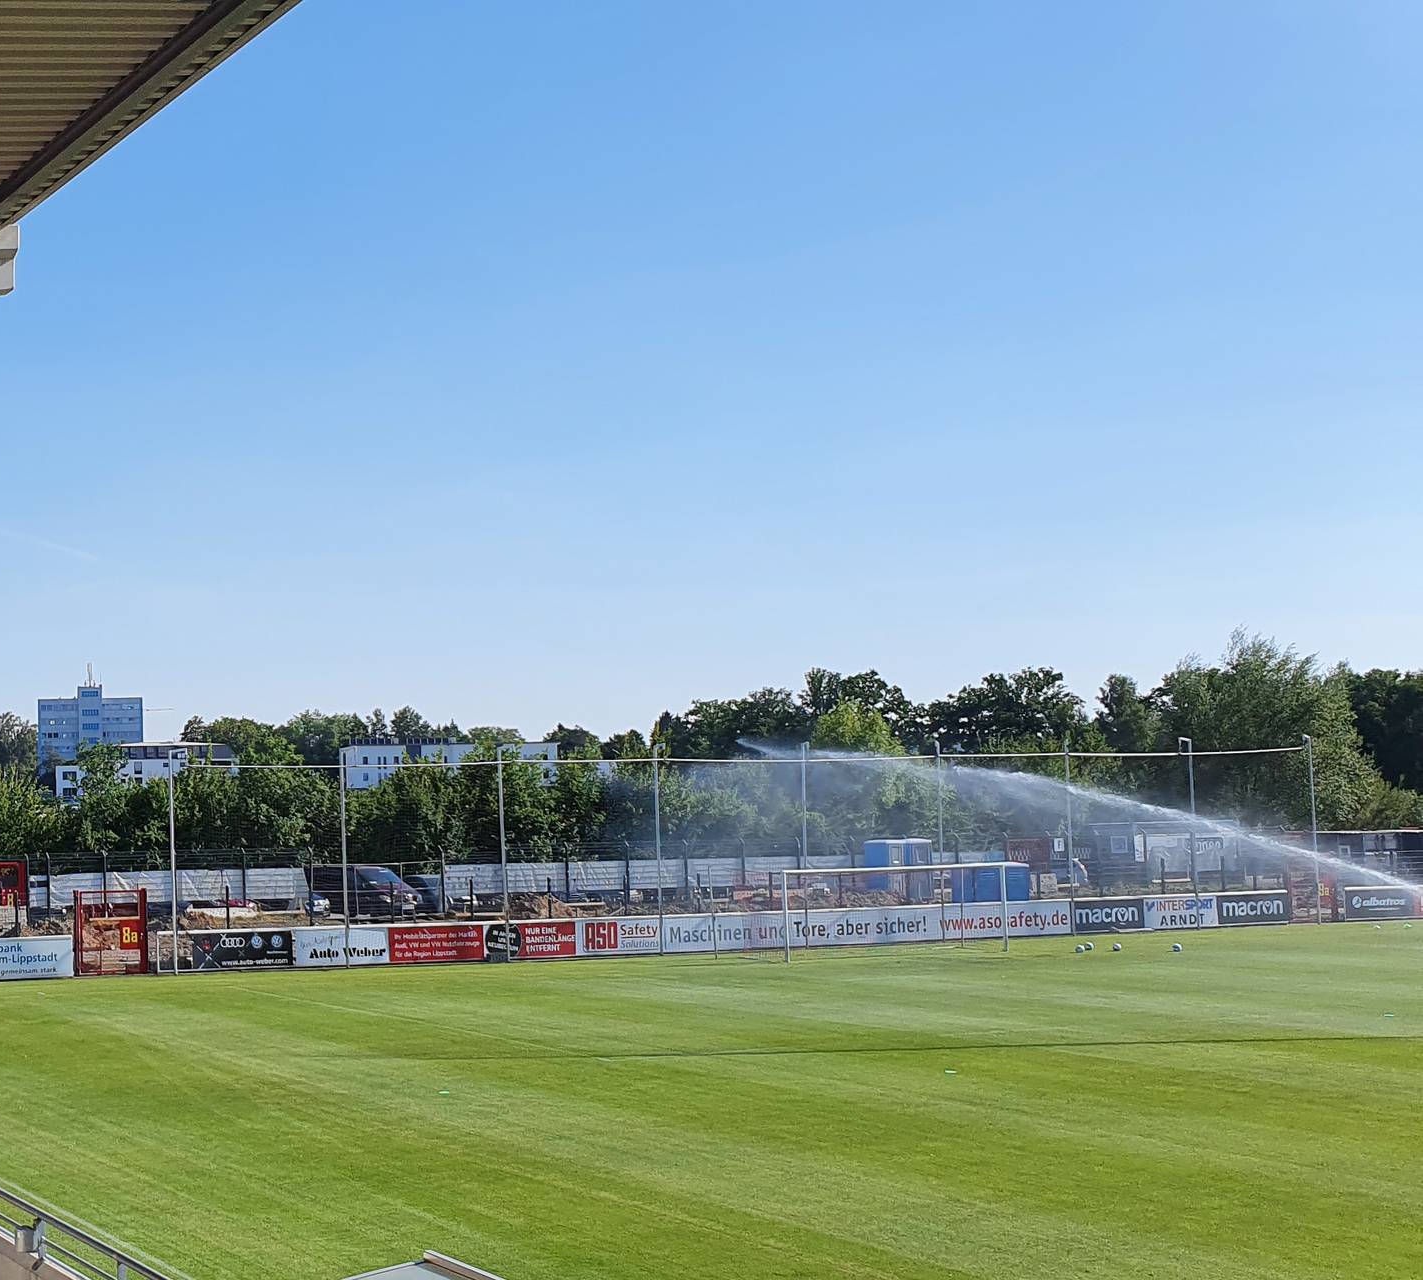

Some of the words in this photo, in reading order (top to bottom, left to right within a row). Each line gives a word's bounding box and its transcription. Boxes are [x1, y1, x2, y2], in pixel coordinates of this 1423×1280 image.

[1156, 898, 1213, 912] INTERSPORT
[1223, 899, 1283, 917] macron
[1362, 896, 1406, 907] albatros
[1076, 907, 1139, 925] macron
[1160, 913, 1205, 926] ARNDT
[122, 926, 138, 943] 8a
[525, 927, 540, 936] NUR
[541, 926, 557, 935] EINE
[585, 922, 618, 950] ASO
[621, 923, 658, 937] Safety
[670, 925, 751, 943] Maschinen
[794, 921, 830, 938] Tore,
[837, 919, 870, 936] aber
[876, 916, 927, 935] sicher!
[525, 933, 575, 944] BANDENLÄNGE
[621, 938, 659, 949] Solutions
[309, 947, 339, 959] Auto
[343, 946, 386, 958] Weber
